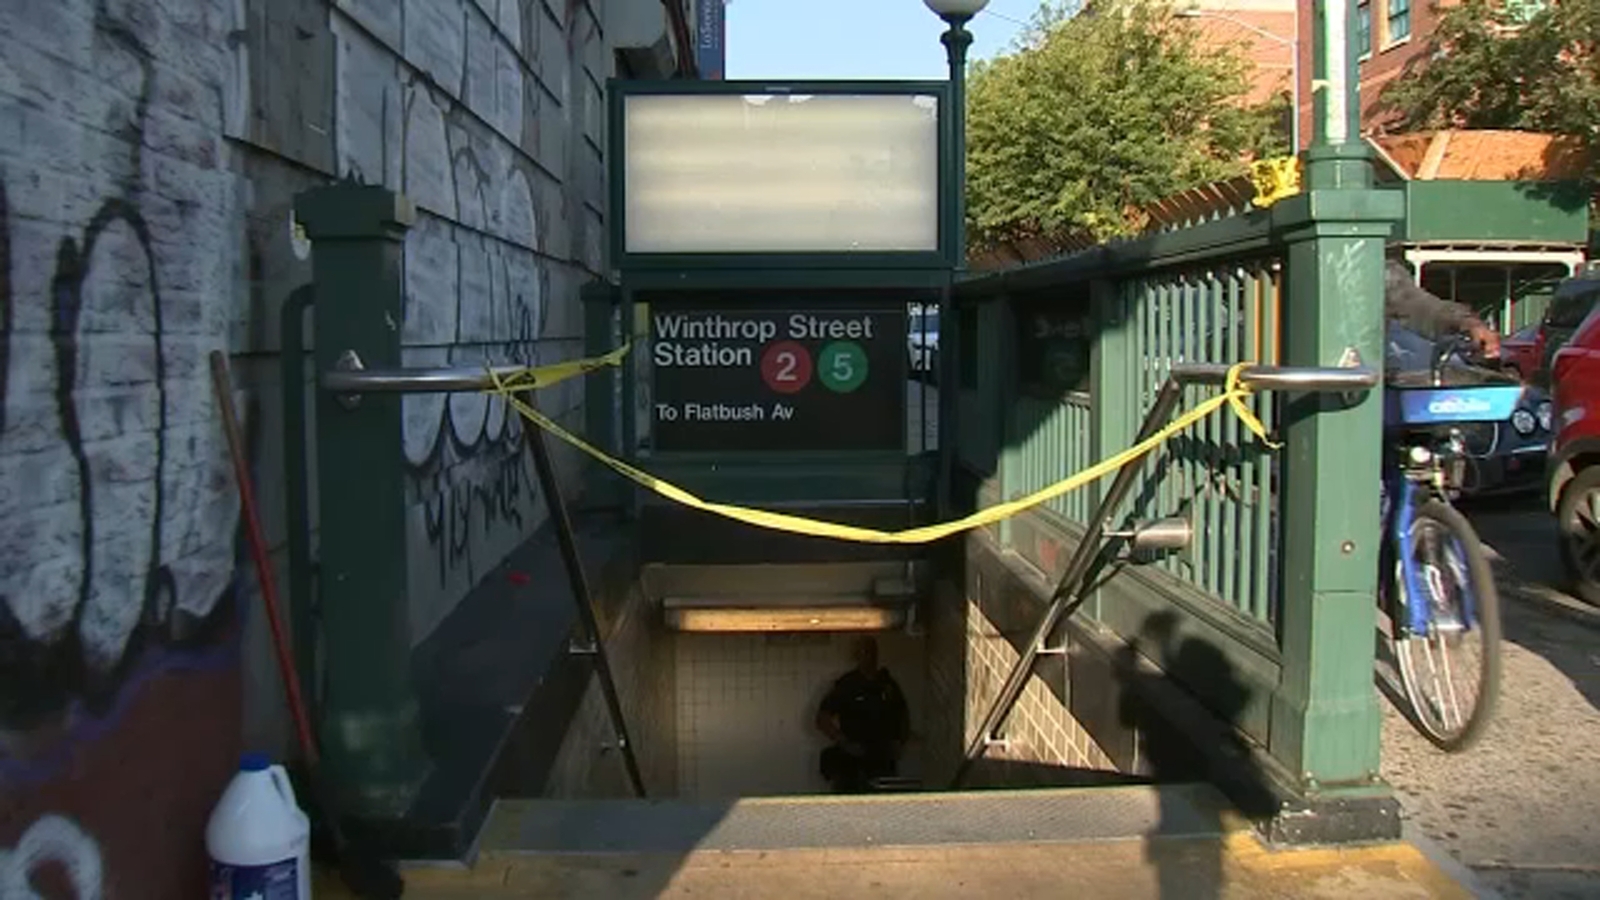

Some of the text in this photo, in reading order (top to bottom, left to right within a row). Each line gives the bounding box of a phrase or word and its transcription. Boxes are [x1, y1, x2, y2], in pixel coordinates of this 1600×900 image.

[654, 314, 874, 342] Winthrop Street
[653, 342, 853, 381] Station 2 5
[656, 403, 795, 421] To Flatbush Av
